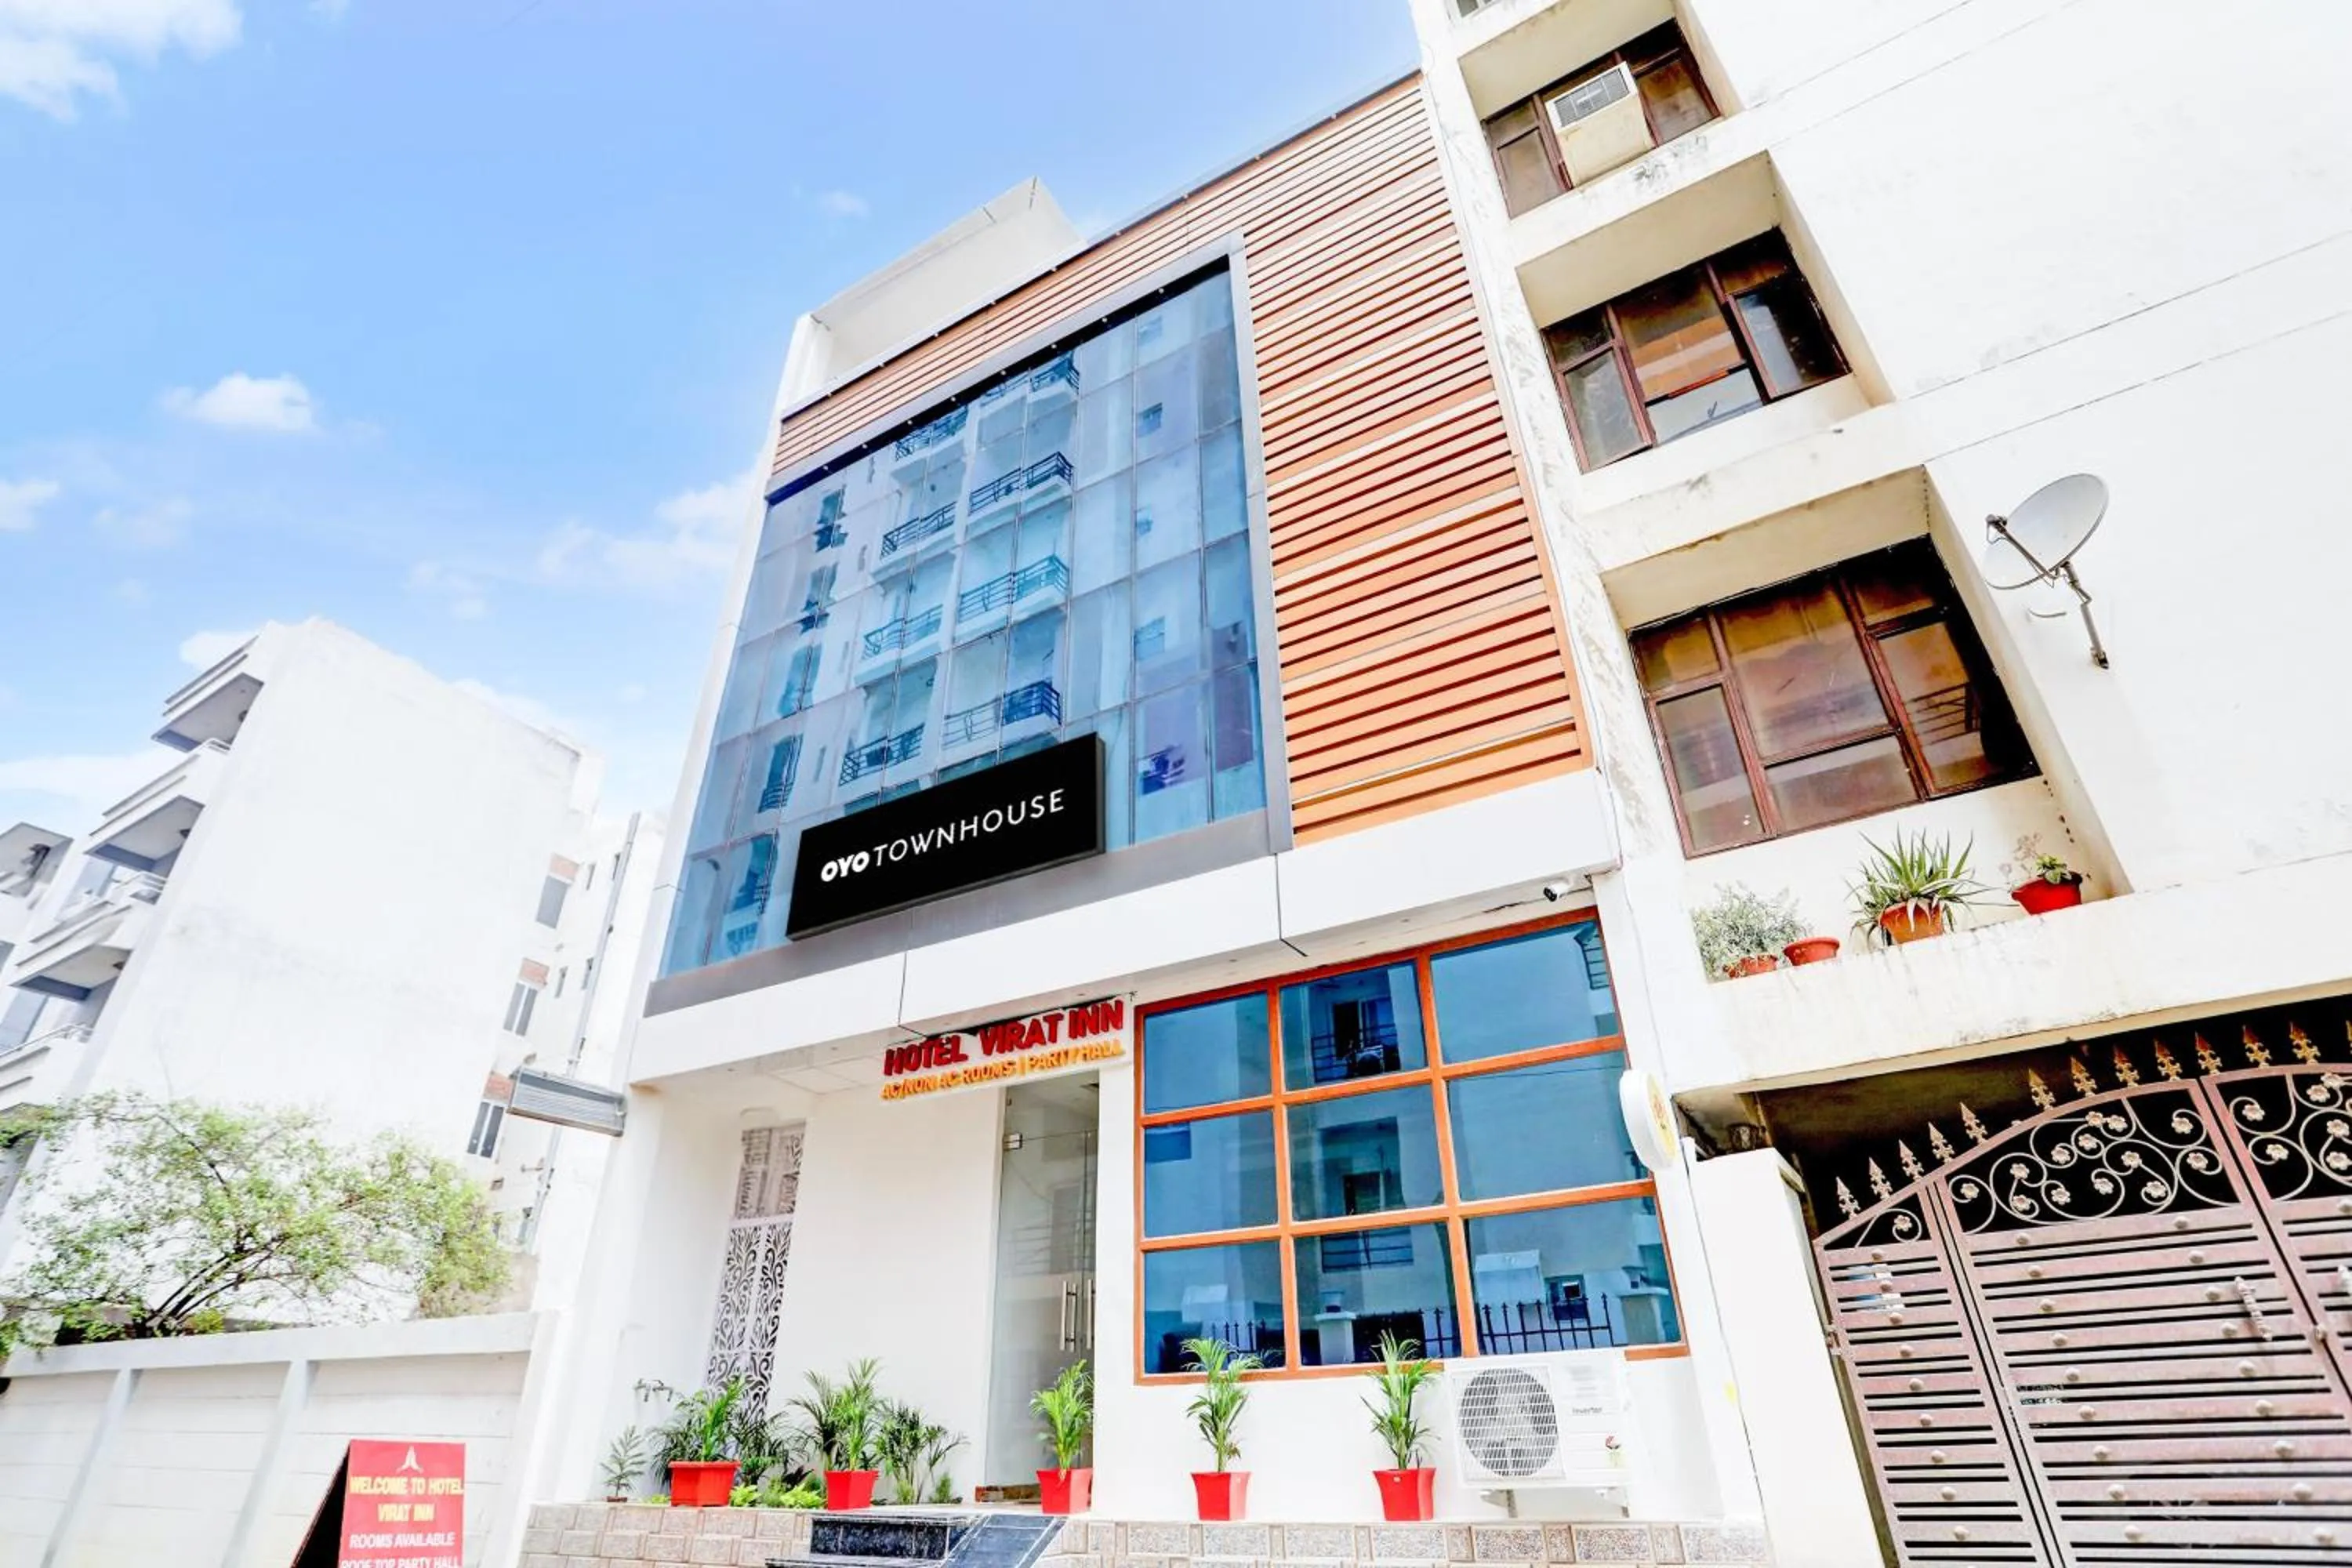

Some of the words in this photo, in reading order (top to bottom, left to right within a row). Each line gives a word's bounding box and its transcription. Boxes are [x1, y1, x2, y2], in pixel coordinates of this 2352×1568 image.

[820, 851, 869, 882] OYO
[873, 788, 1065, 866] TOWNHOUSE
[884, 1035, 968, 1076] HOTEL
[979, 1013, 1063, 1056] VIRAT
[1068, 1000, 1123, 1040] INN
[350, 1476, 408, 1494] WELCOME
[411, 1477, 426, 1494] TO
[428, 1477, 464, 1495] HOTEL
[377, 1503, 412, 1522] VIRAT
[413, 1503, 435, 1522] INN
[350, 1534, 393, 1549] ROOMS
[394, 1531, 456, 1548] AVAILABLE
